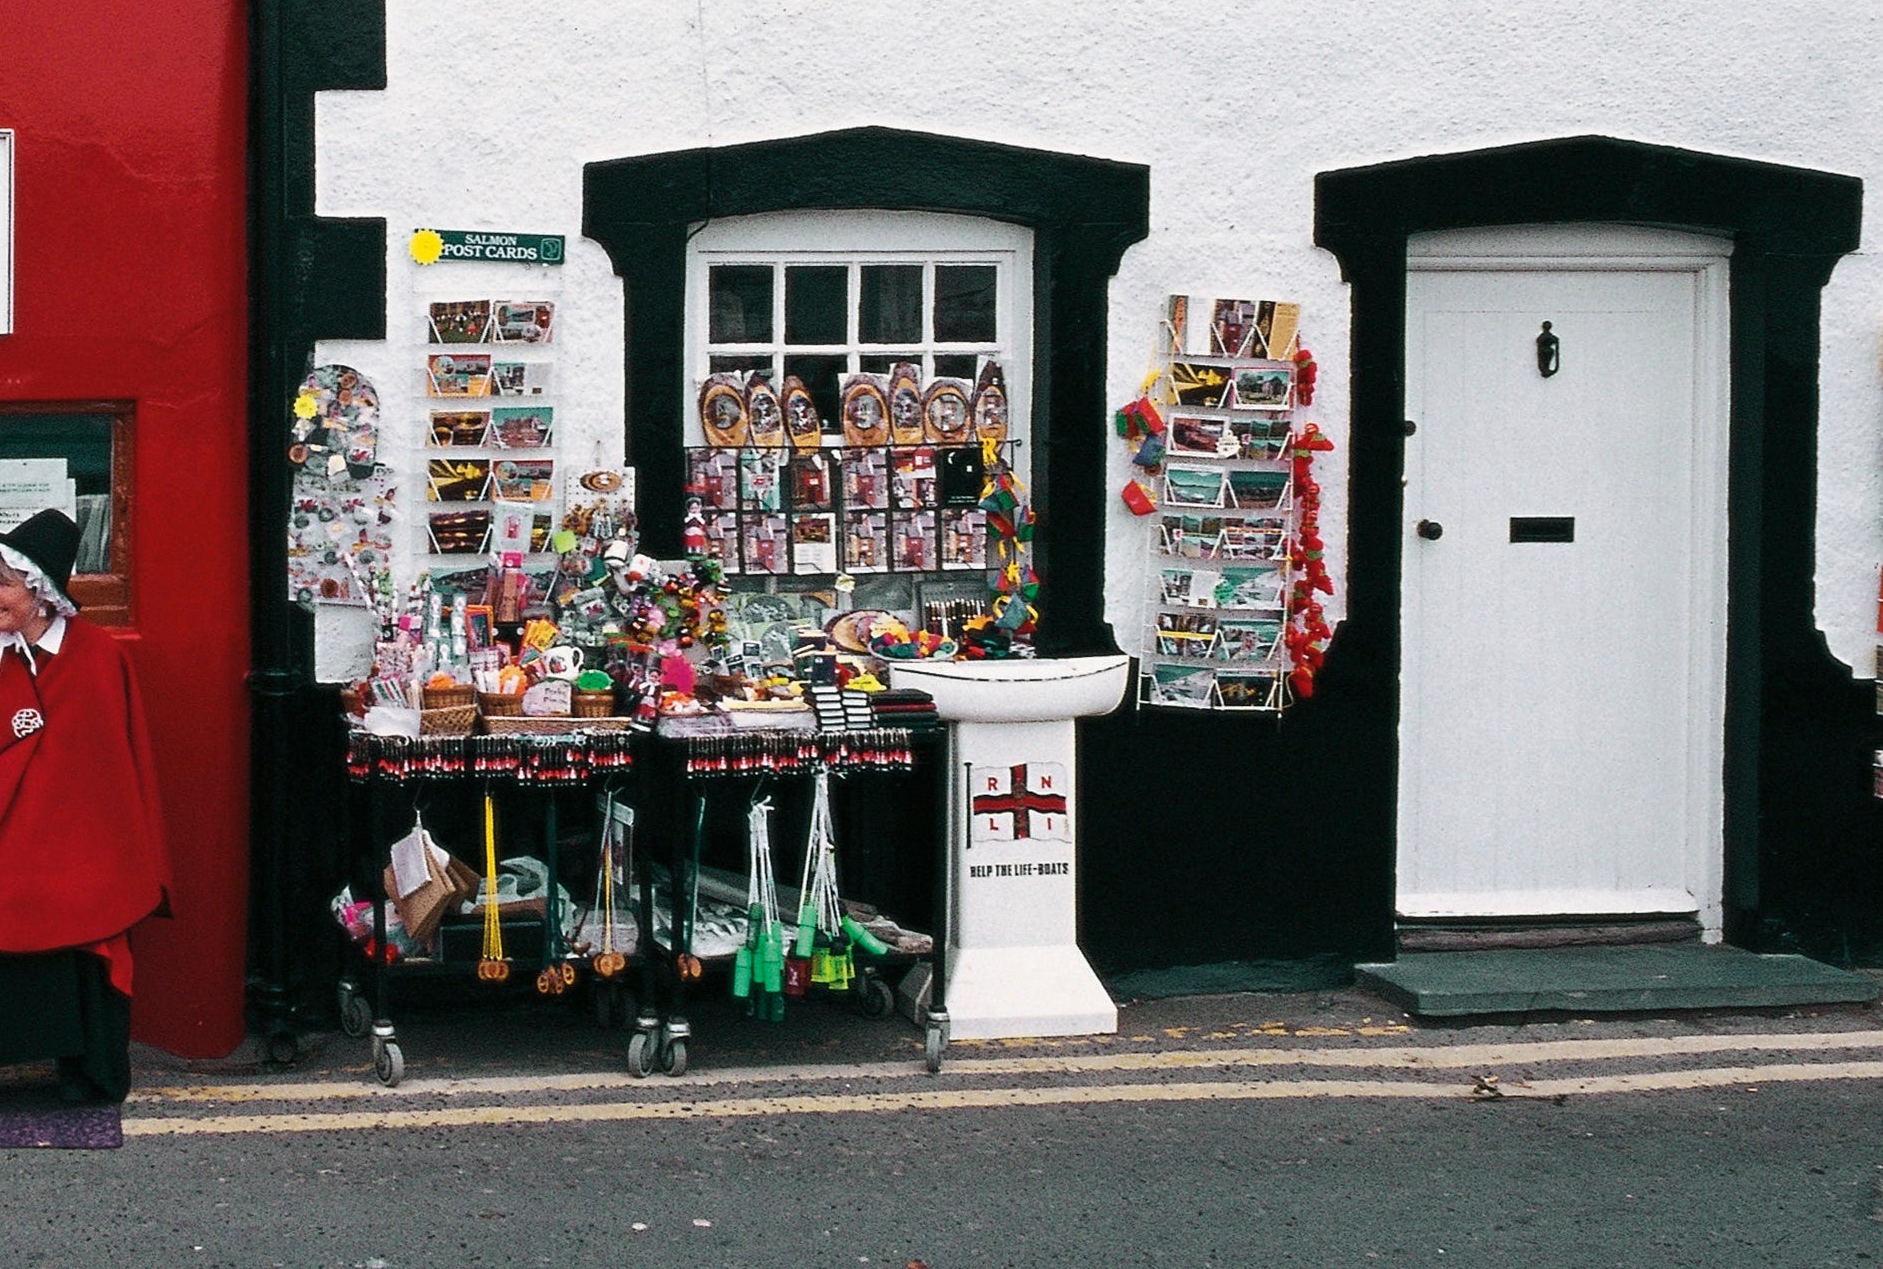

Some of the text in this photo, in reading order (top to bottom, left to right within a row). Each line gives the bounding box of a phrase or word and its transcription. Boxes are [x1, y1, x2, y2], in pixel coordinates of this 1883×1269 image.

[465, 234, 517, 246] SALMON
[443, 243, 538, 260] POST CARDS
[987, 775, 1052, 791] R N
[989, 818, 999, 831] L
[970, 862, 1069, 878] HELP THE LIFE-BOATS
